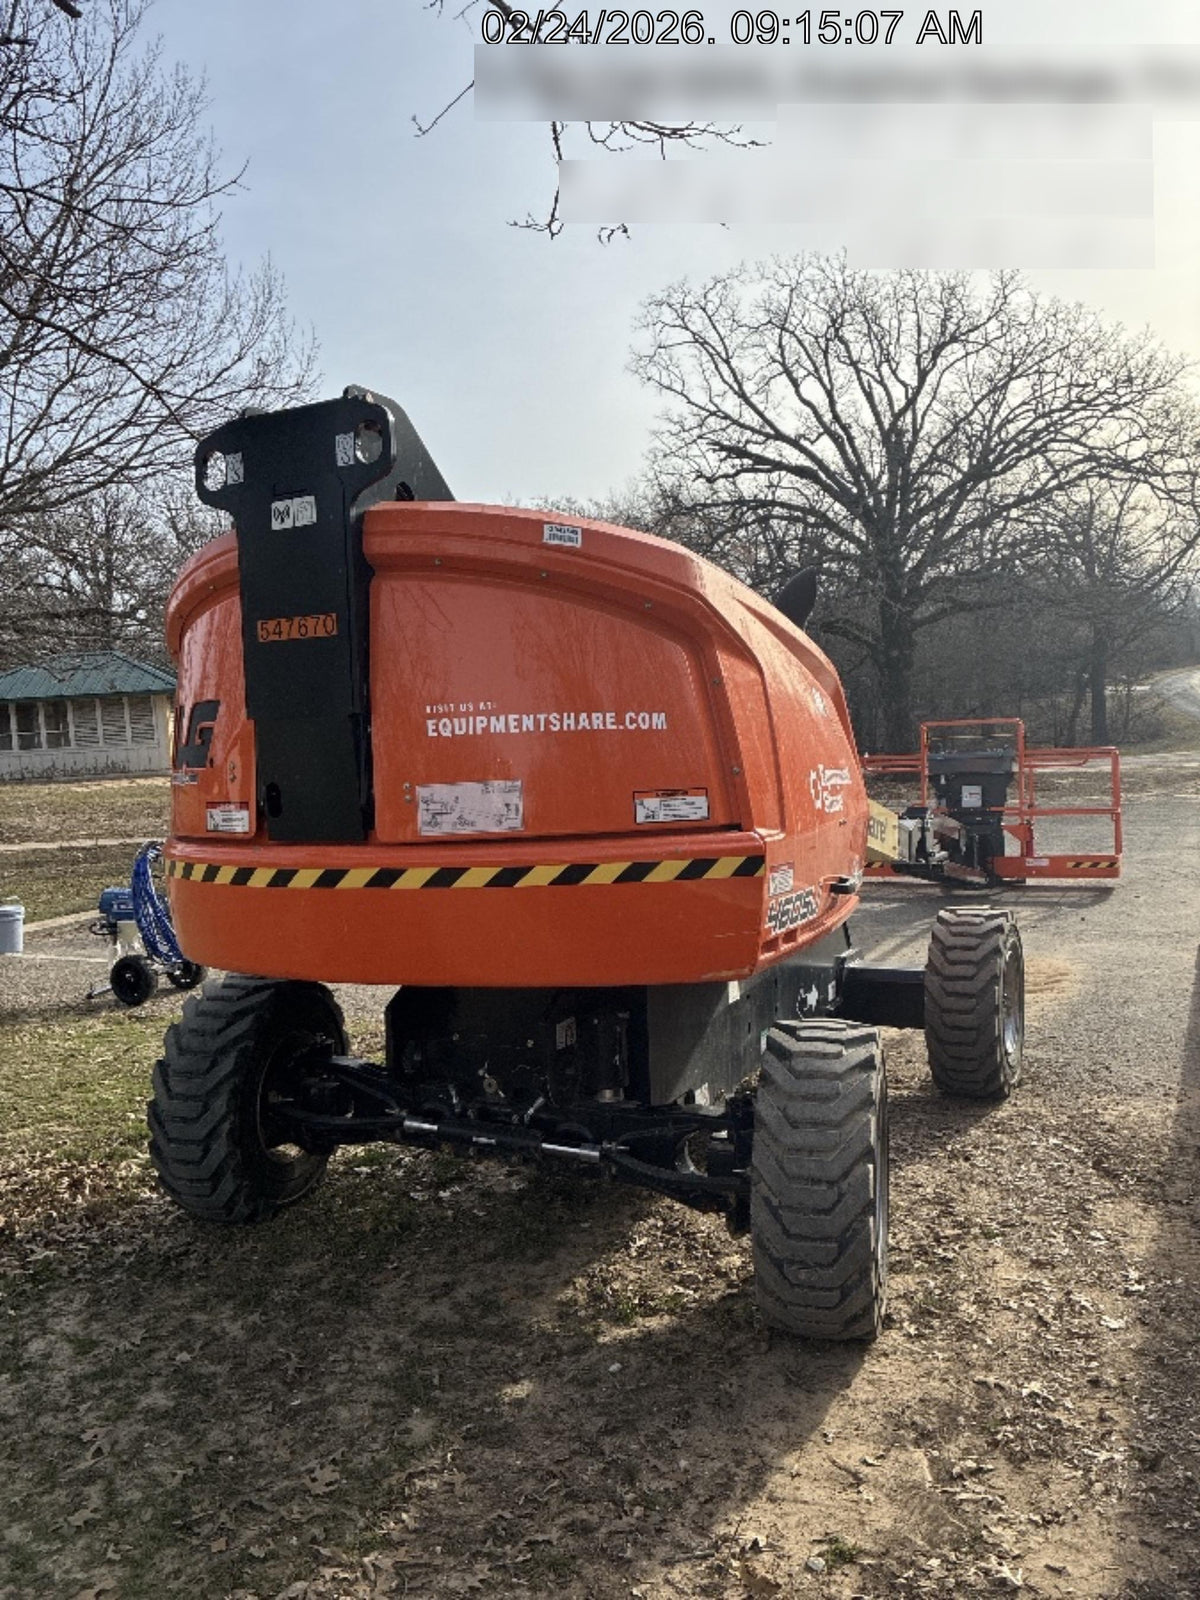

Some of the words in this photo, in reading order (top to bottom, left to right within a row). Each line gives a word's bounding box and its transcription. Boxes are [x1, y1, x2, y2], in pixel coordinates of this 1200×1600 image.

[260, 614, 335, 640] 547670
[460, 702, 474, 712] US
[425, 711, 668, 738] EQUIPMENTSHARE.COM
